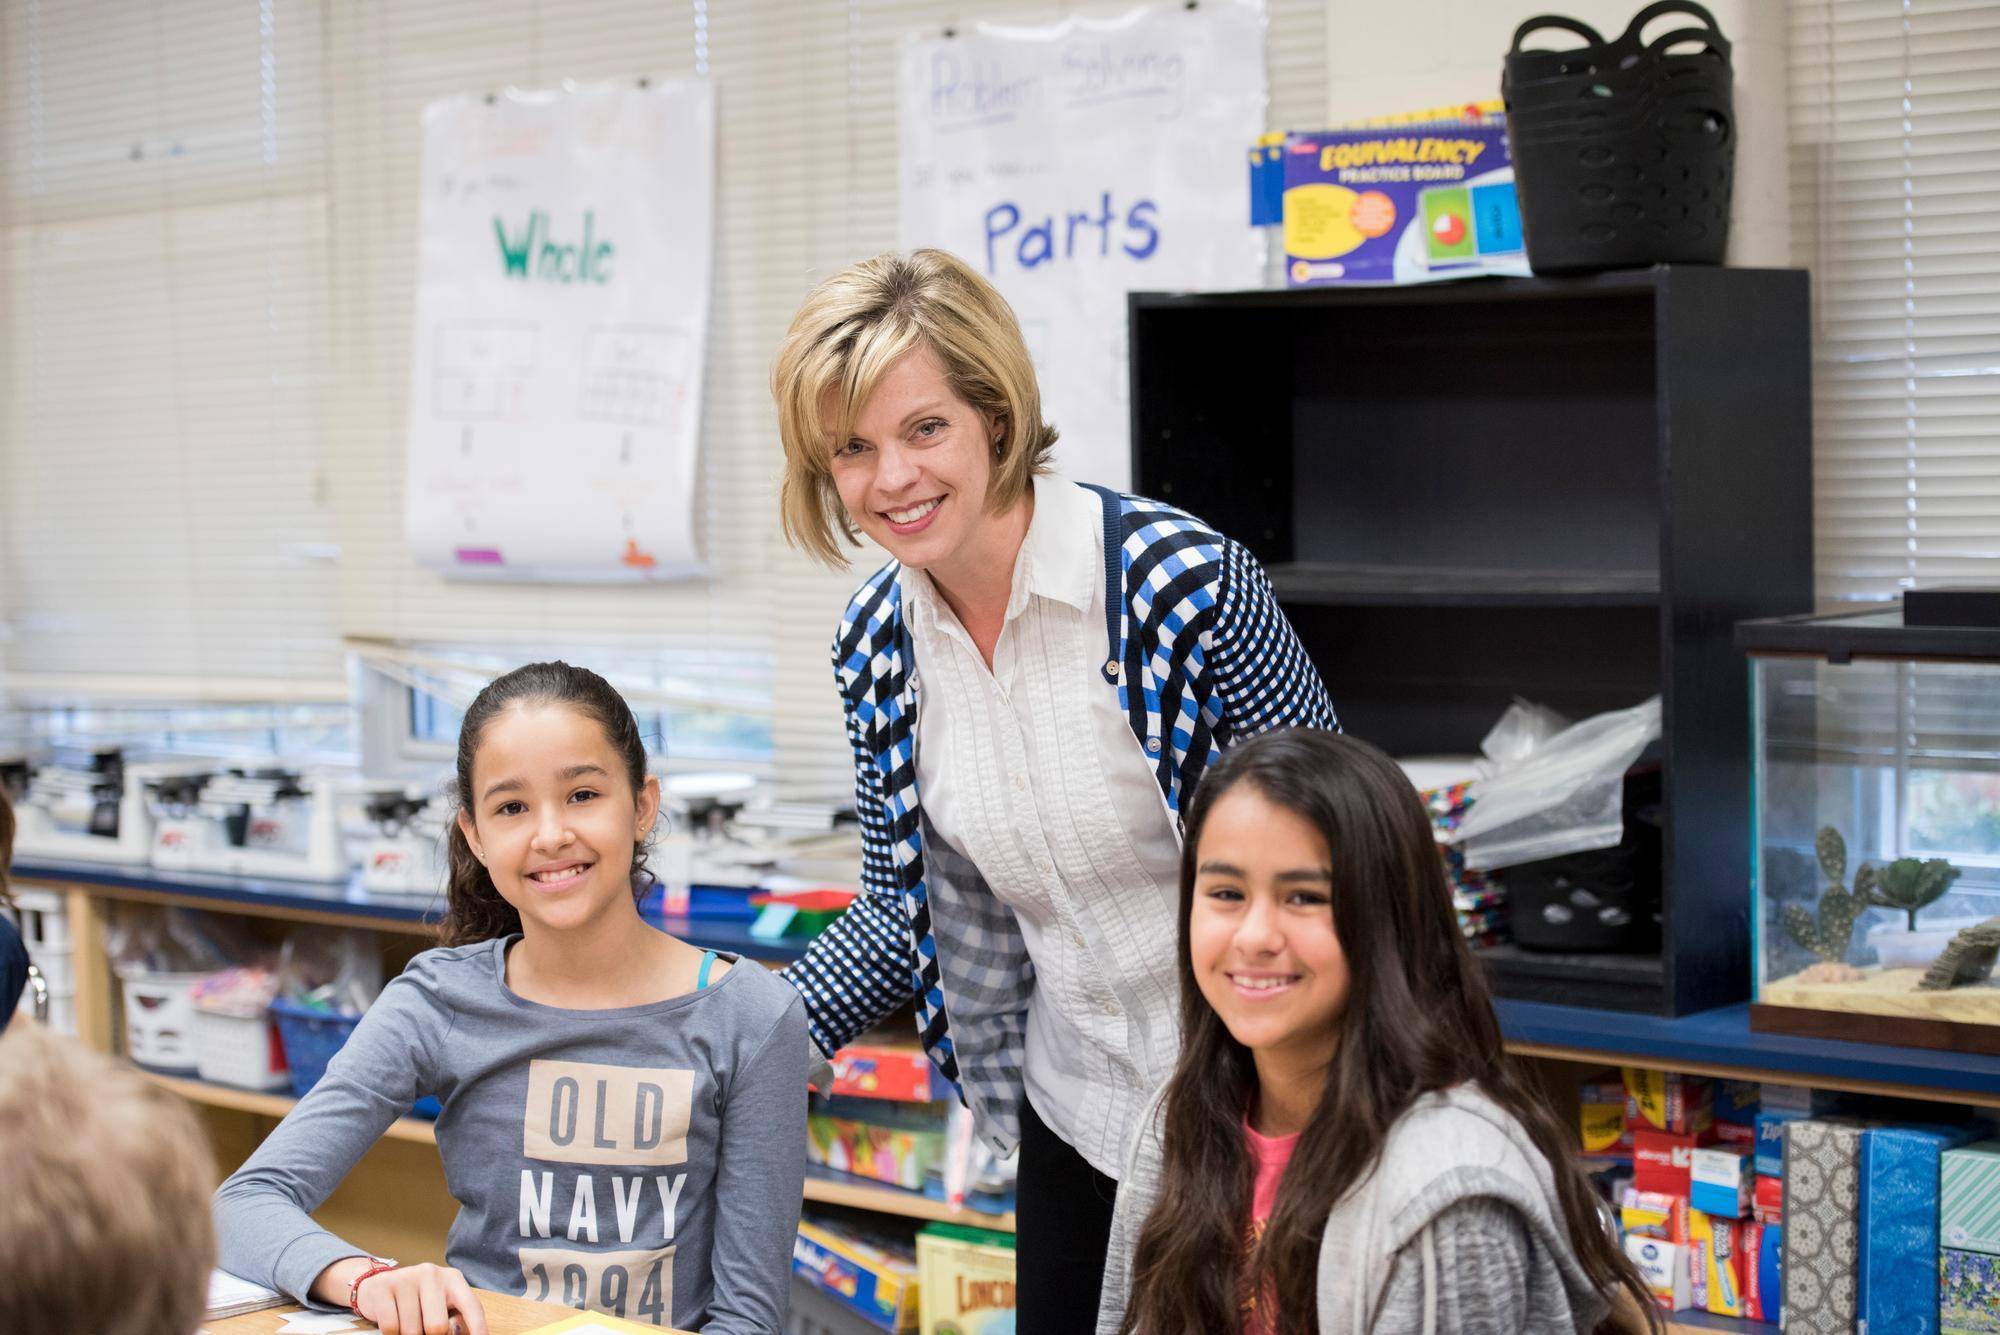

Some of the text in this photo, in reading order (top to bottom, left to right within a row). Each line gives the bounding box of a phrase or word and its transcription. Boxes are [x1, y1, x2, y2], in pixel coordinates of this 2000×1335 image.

[1319, 137, 1486, 172] EQUIVALENCY
[1338, 164, 1466, 183] PRACTICE BOARD
[492, 208, 615, 286] Whole
[984, 192, 1159, 275] Parts
[549, 1076, 664, 1150] OLD
[518, 1169, 688, 1243] NAVY
